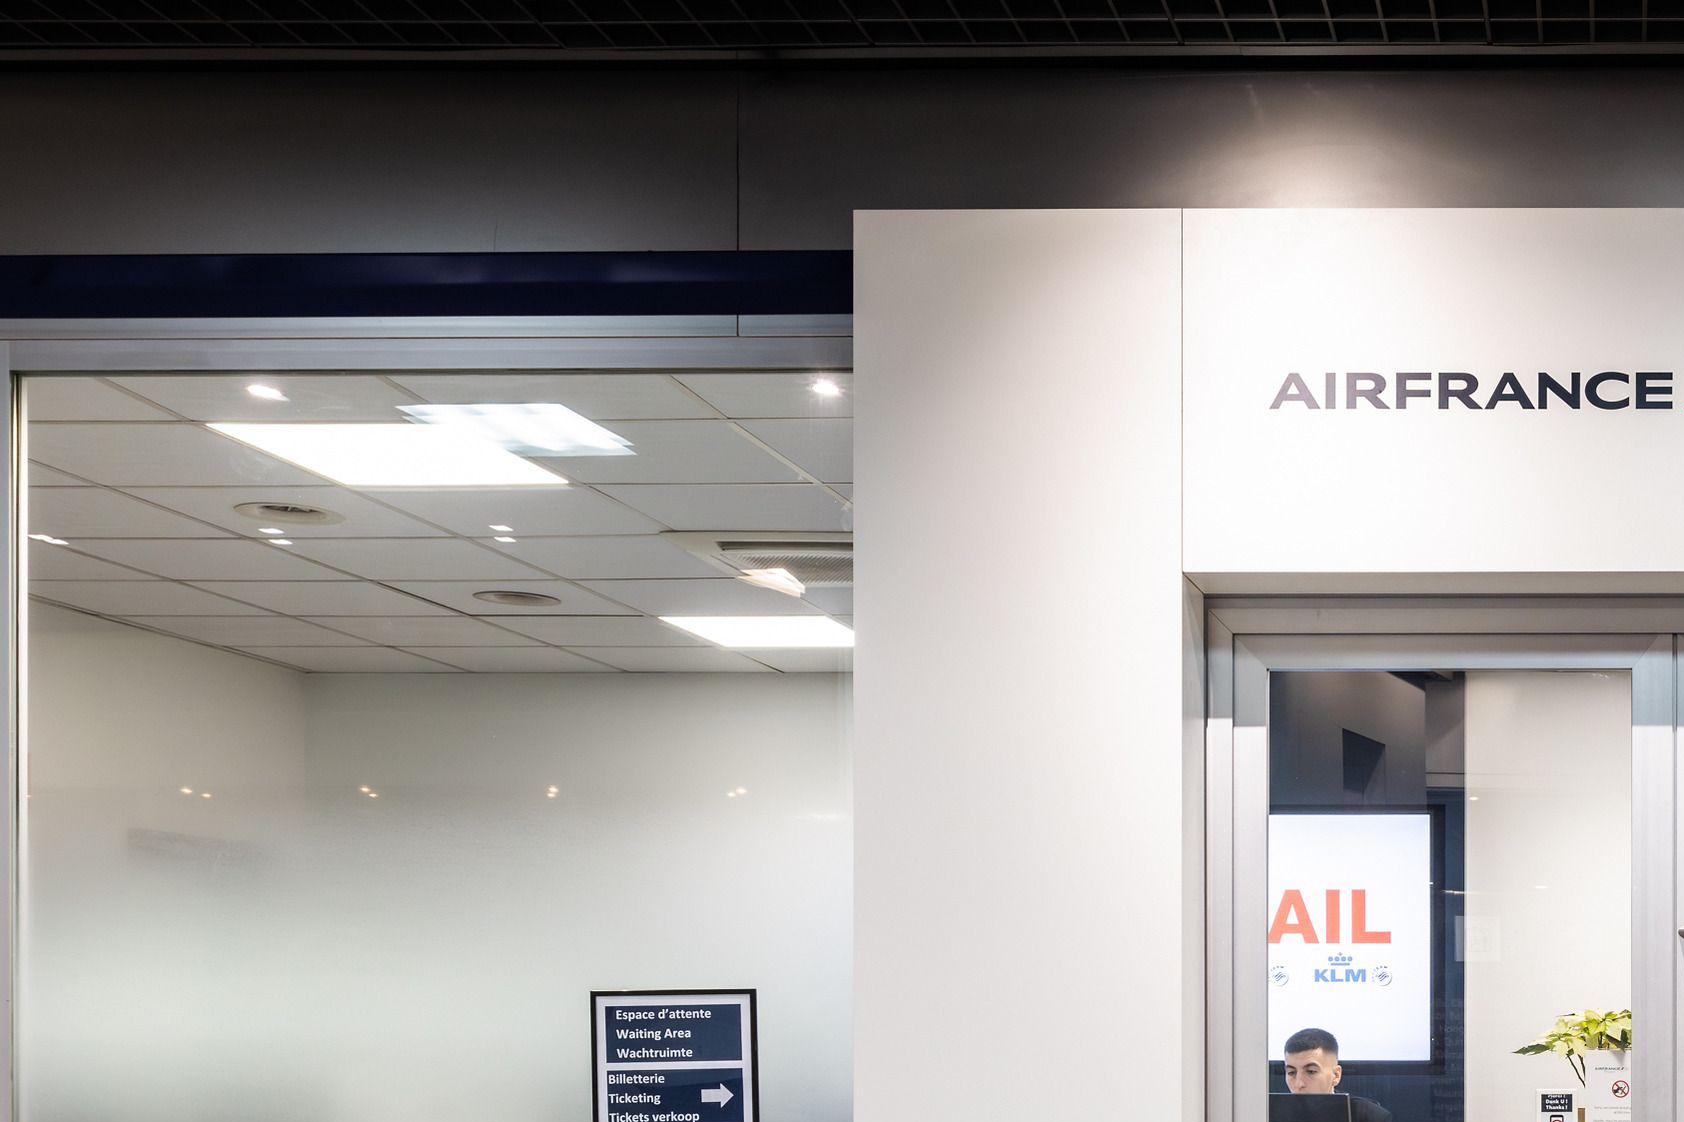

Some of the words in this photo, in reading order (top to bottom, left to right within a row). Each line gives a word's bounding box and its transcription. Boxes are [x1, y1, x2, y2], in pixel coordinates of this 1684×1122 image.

[1269, 371, 1673, 410] AIRFRANCE
[1268, 889, 1392, 944] AIL
[1314, 969, 1367, 983] KLM
[616, 1009, 655, 1022] Espace
[616, 1028, 661, 1041] Waiting
[664, 1028, 691, 1039] Area
[616, 1047, 693, 1059] Wachtruimte
[608, 1073, 665, 1085] Billetterie
[608, 1093, 661, 1105] Ticketing
[609, 1112, 650, 1122] Tickets
